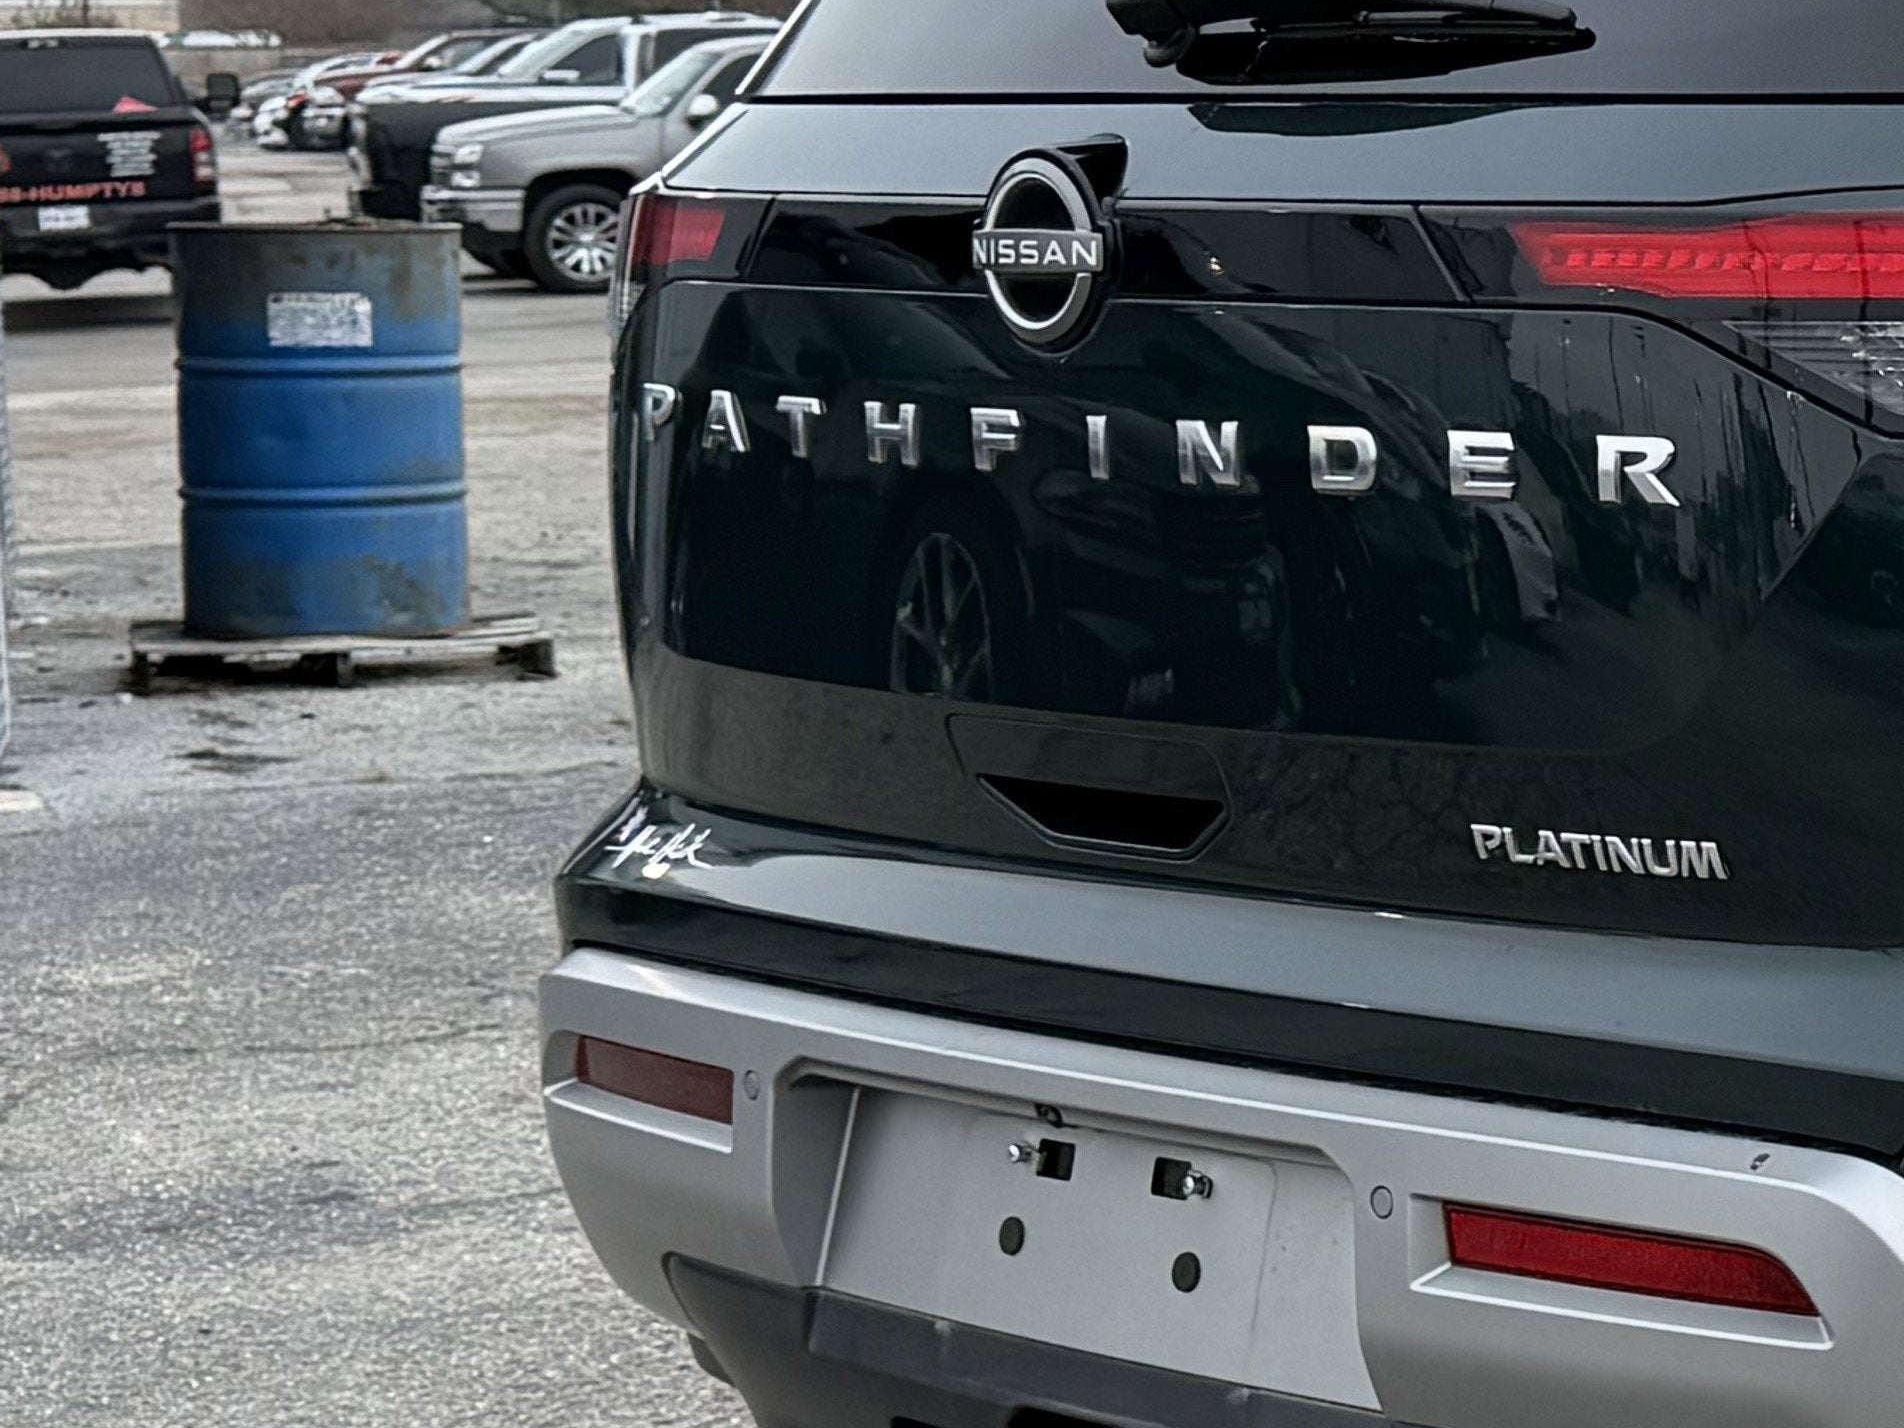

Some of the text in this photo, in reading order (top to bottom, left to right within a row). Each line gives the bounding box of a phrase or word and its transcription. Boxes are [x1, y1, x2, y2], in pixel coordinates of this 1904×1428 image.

[973, 237, 1097, 266] NISSAN
[643, 382, 1681, 508] PATHFINDER
[1470, 823, 1729, 880] PLATINUM
